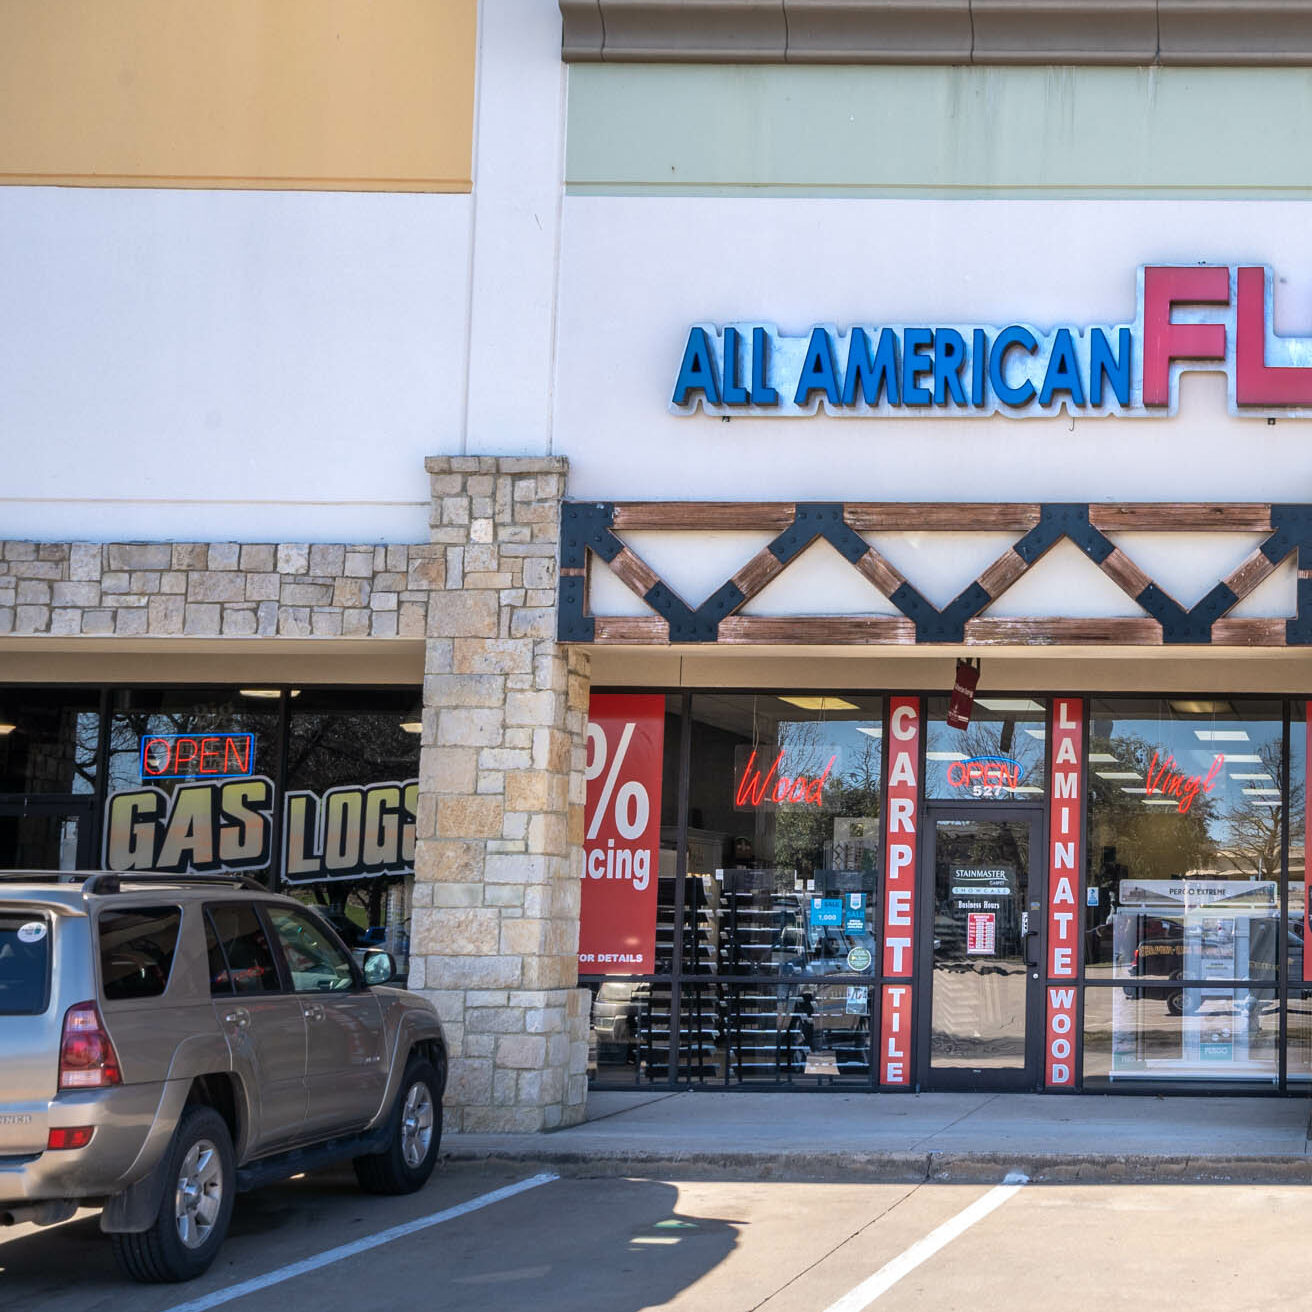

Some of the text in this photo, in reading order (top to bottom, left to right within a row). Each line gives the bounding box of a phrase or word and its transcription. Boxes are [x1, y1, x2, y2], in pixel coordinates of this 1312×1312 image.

[672, 327, 779, 406] ALL
[793, 325, 1132, 408] AMERICAN
[144, 735, 251, 775] OPEN
[736, 749, 837, 807] Wood
[946, 760, 1020, 790] OPEN
[972, 784, 1002, 797] 527
[1146, 751, 1225, 814] Vinyl
[102, 776, 275, 874] GAS
[885, 706, 919, 1082] CARPET TILE
[955, 869, 1006, 878] STAINMASTER
[1049, 702, 1078, 1083] LAMINATE WOOD
[958, 900, 1000, 909] Business Hours
[597, 953, 643, 963] DETAILS
